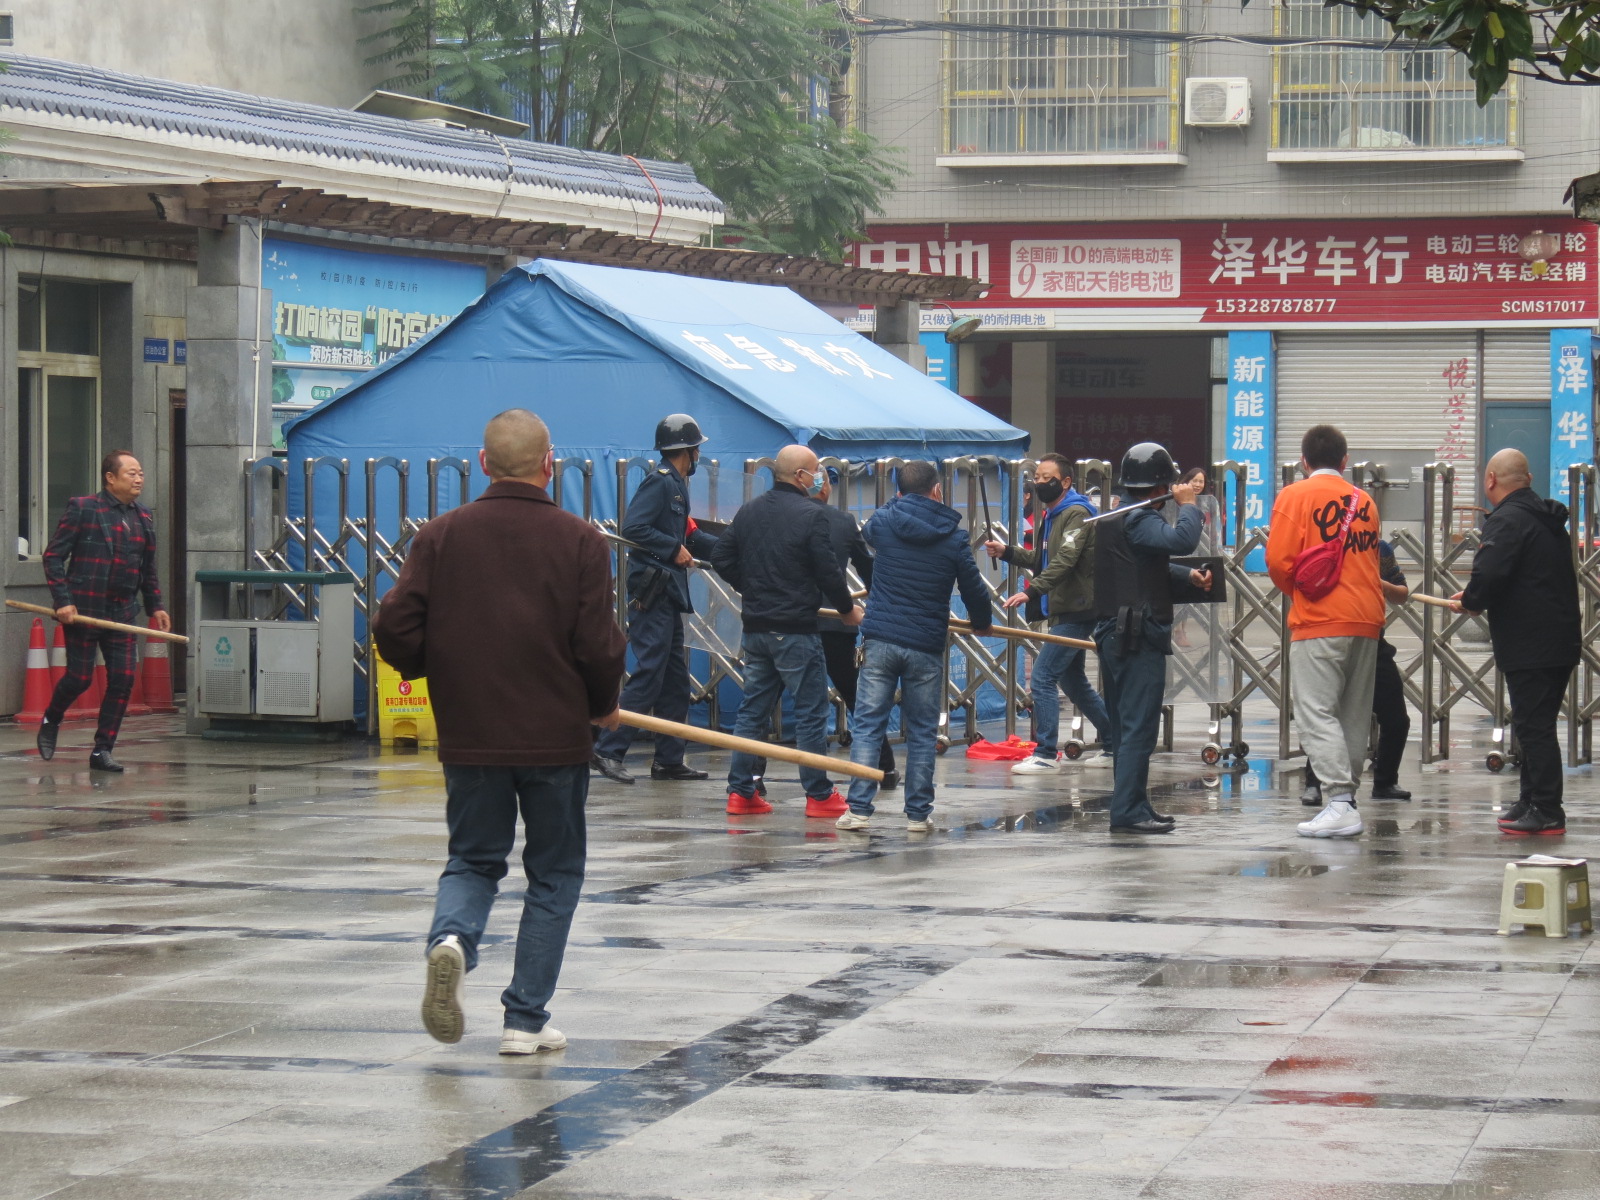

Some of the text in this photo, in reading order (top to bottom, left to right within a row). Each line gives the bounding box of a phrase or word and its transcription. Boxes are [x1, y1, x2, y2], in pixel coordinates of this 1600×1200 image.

[1208, 235, 1410, 286] 泽华车行
[1215, 299, 1337, 313] 15328787877
[1501, 301, 1586, 313] SCMS17017
